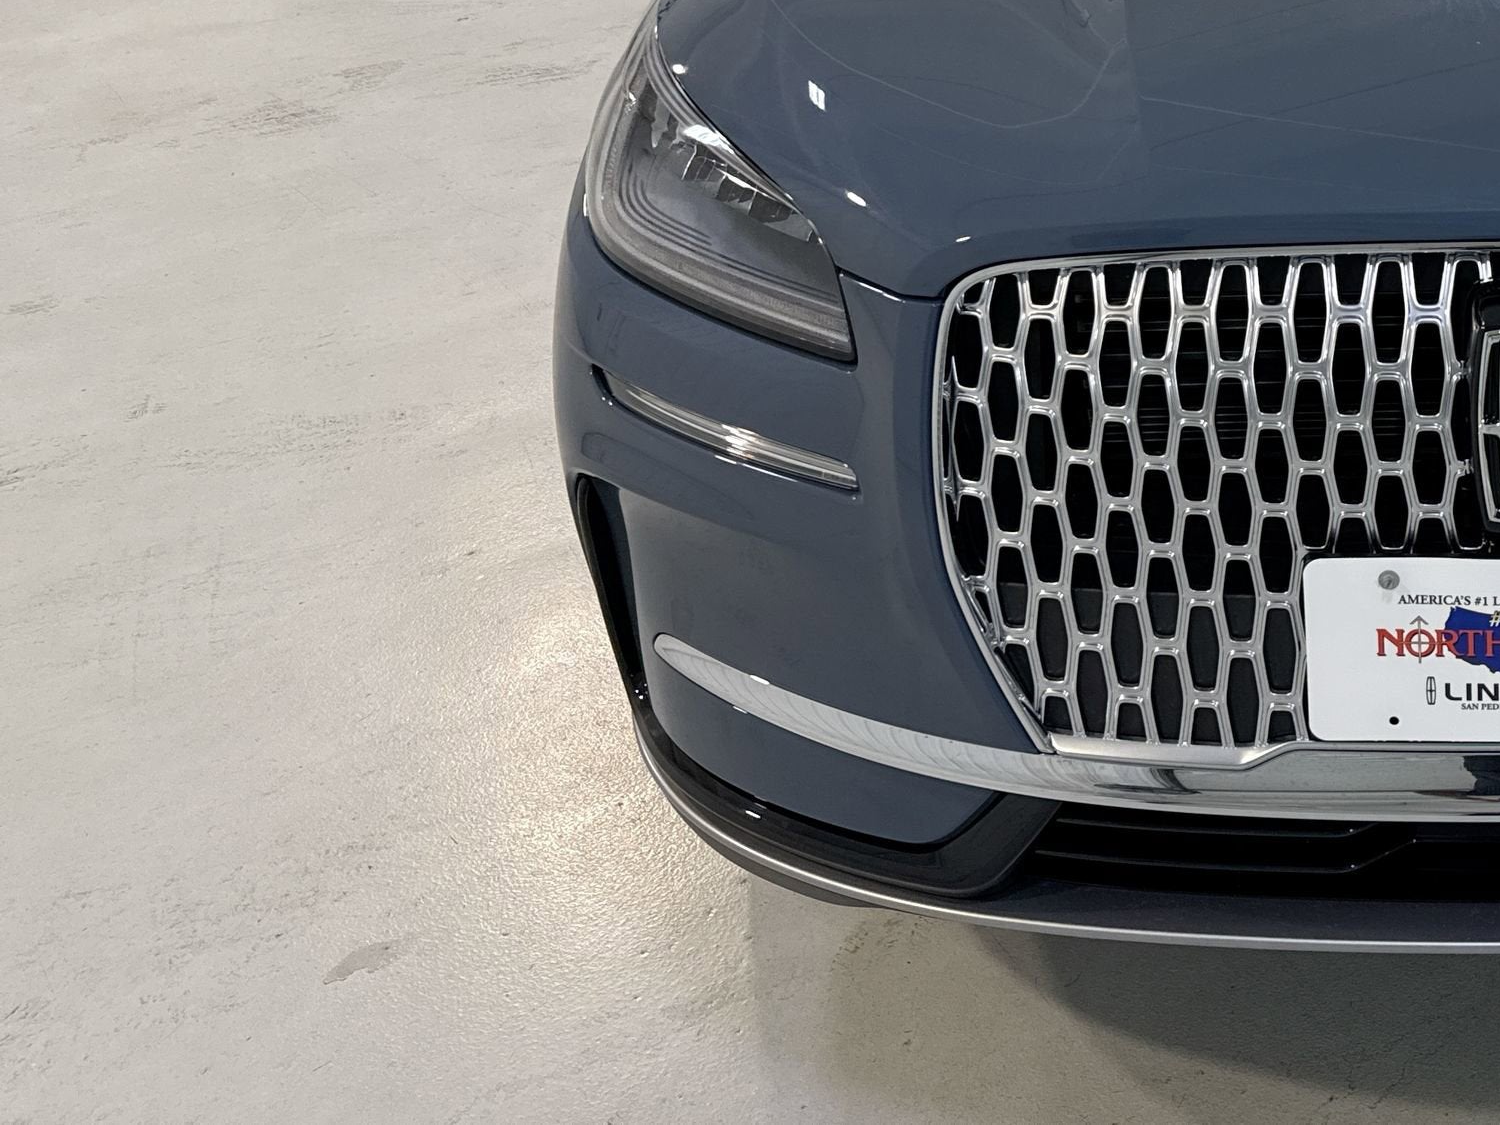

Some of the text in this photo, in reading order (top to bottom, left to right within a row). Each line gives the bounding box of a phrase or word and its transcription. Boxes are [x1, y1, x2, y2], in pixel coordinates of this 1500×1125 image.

[1397, 593, 1471, 606] AMERICA'S
[1474, 595, 1488, 606] #1
[1461, 702, 1479, 711] SAN
